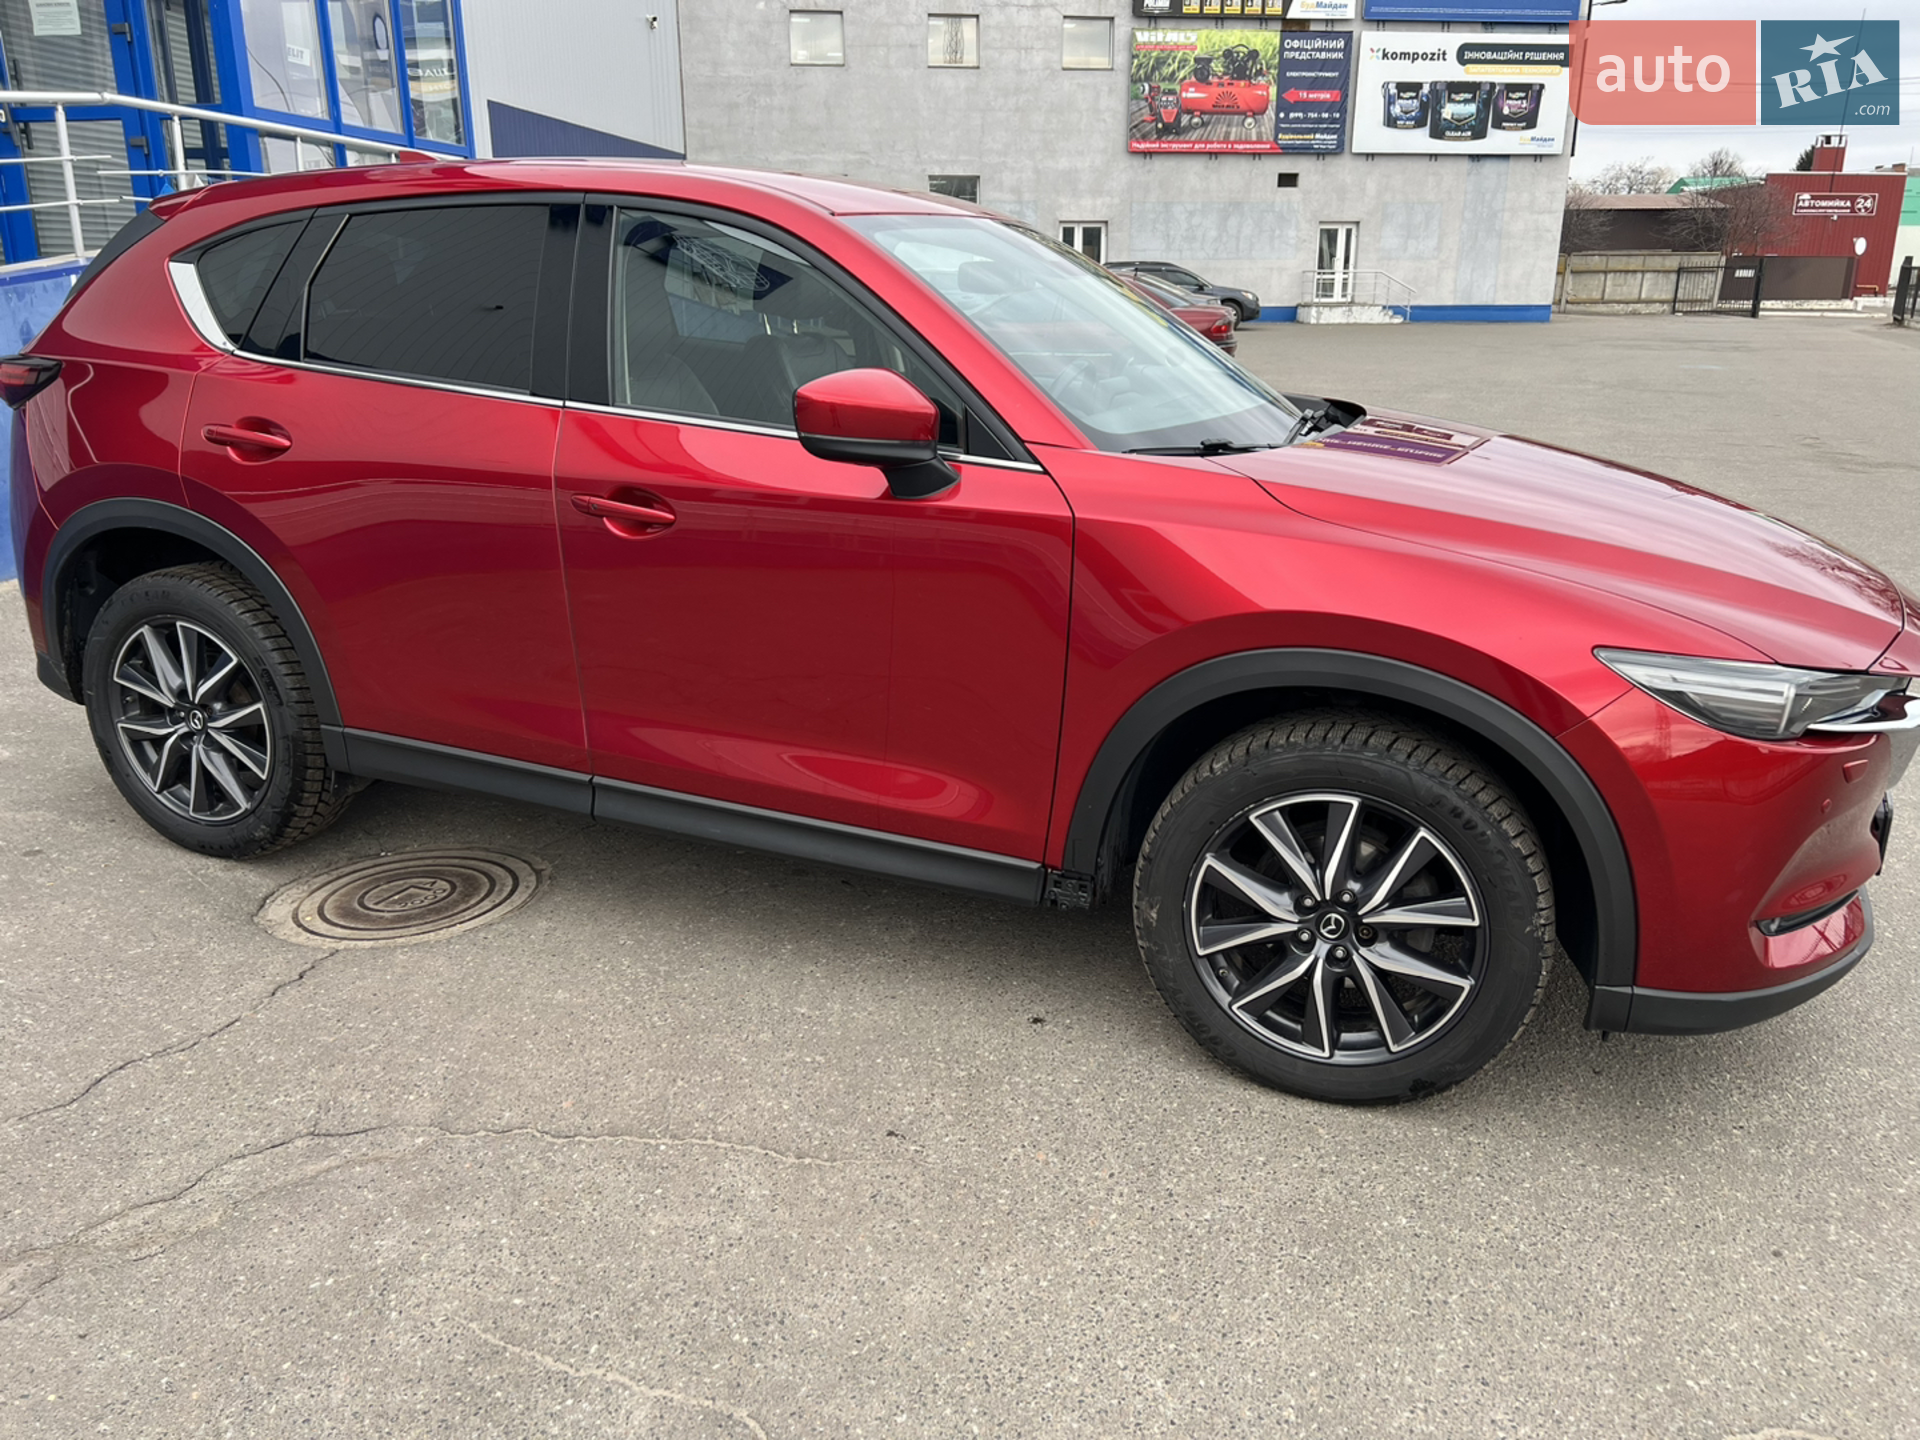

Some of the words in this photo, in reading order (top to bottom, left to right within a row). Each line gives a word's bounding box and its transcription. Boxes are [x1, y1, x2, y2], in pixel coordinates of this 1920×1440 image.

[1284, 38, 1345, 50] ОФІЦІЙНИЙ
[1283, 51, 1344, 60] ПРЕДСТАВНИК
[1381, 48, 1447, 64] kompozit
[1464, 50, 1523, 60] ІННОВАЦІЙНІ
[1525, 52, 1565, 61] РІШЕННЯ
[1797, 199, 1851, 207] АВТОМИЙКА
[1856, 199, 1872, 208] 24
